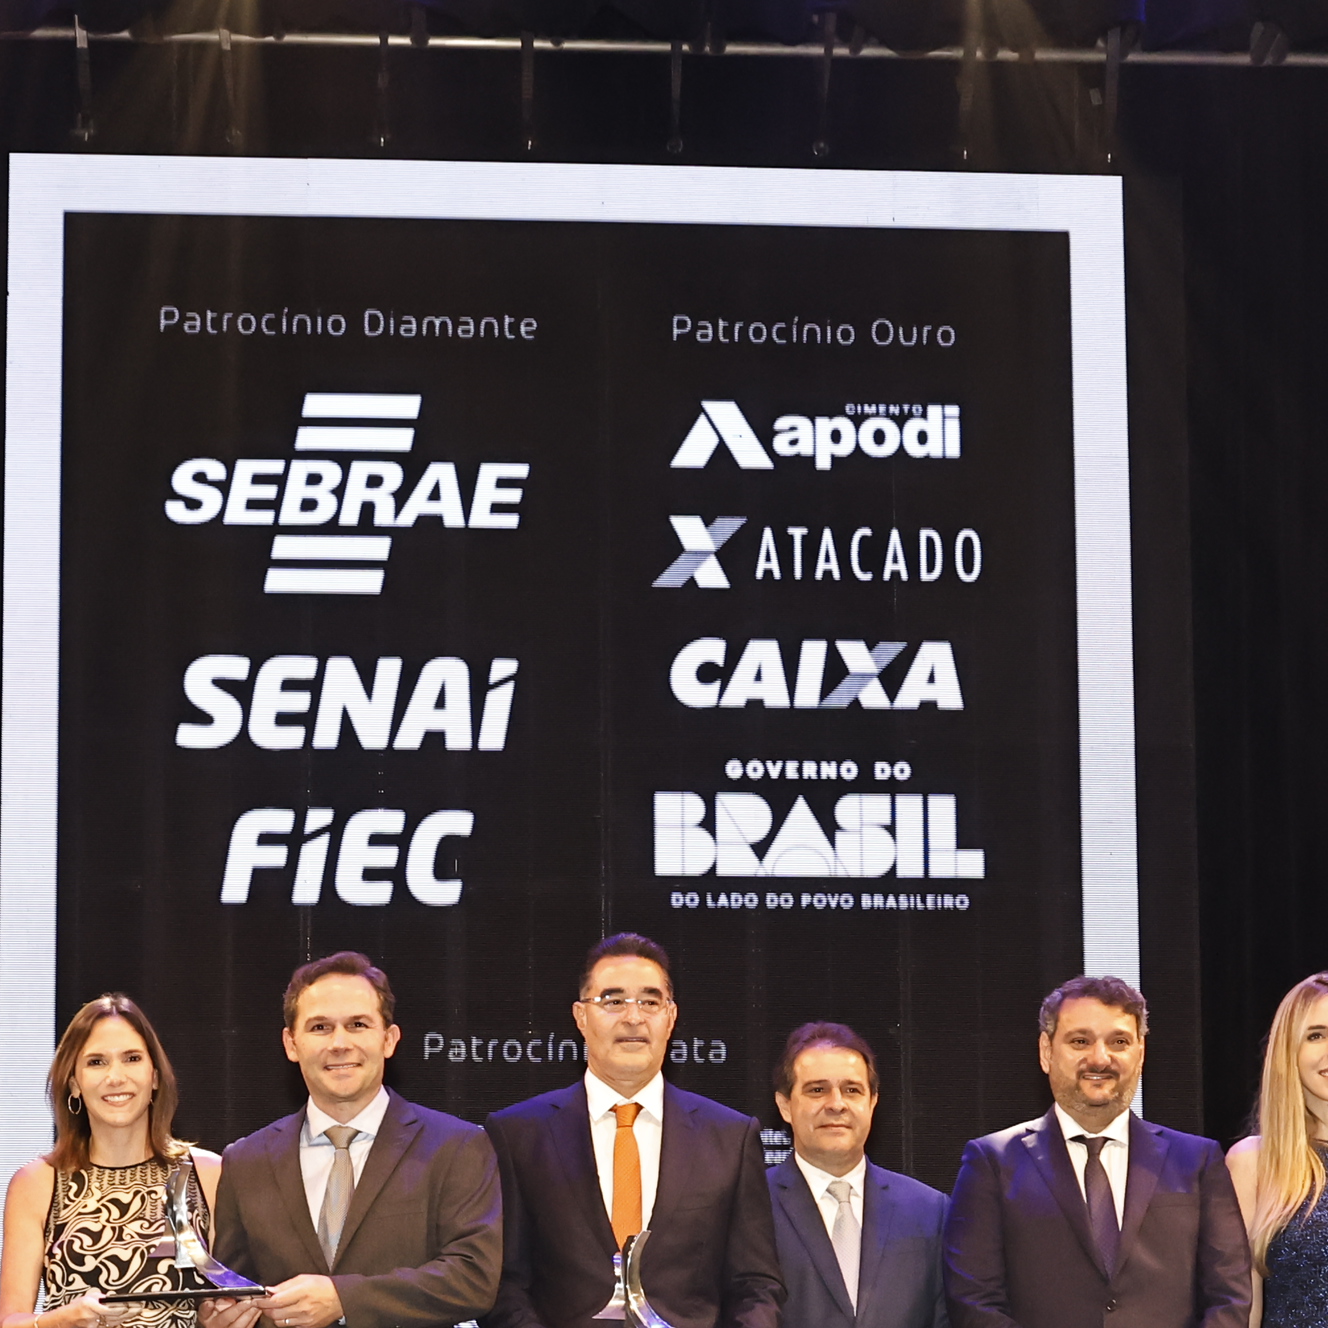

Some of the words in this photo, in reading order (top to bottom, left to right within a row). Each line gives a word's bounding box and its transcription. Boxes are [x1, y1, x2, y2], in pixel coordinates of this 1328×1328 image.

[159, 305, 347, 338] Patrocínio
[363, 308, 538, 341] Diamante
[672, 314, 856, 346] Patrocínio
[871, 318, 956, 348] Ouro
[771, 403, 962, 471] apodi
[164, 457, 530, 530] SEBRAE
[755, 525, 983, 583] ATACADO
[668, 637, 965, 711] CAIXA
[724, 759, 859, 782] GOVERNO
[873, 760, 912, 782] DO
[653, 791, 986, 879] BRASIL
[670, 891, 701, 909] DO
[705, 891, 760, 910] LADO
[765, 892, 795, 910] DO
[800, 892, 855, 910] POVO
[860, 892, 971, 911] BRASILEIRO
[422, 1031, 588, 1064] Patrocíni
[670, 1036, 729, 1064] ata
